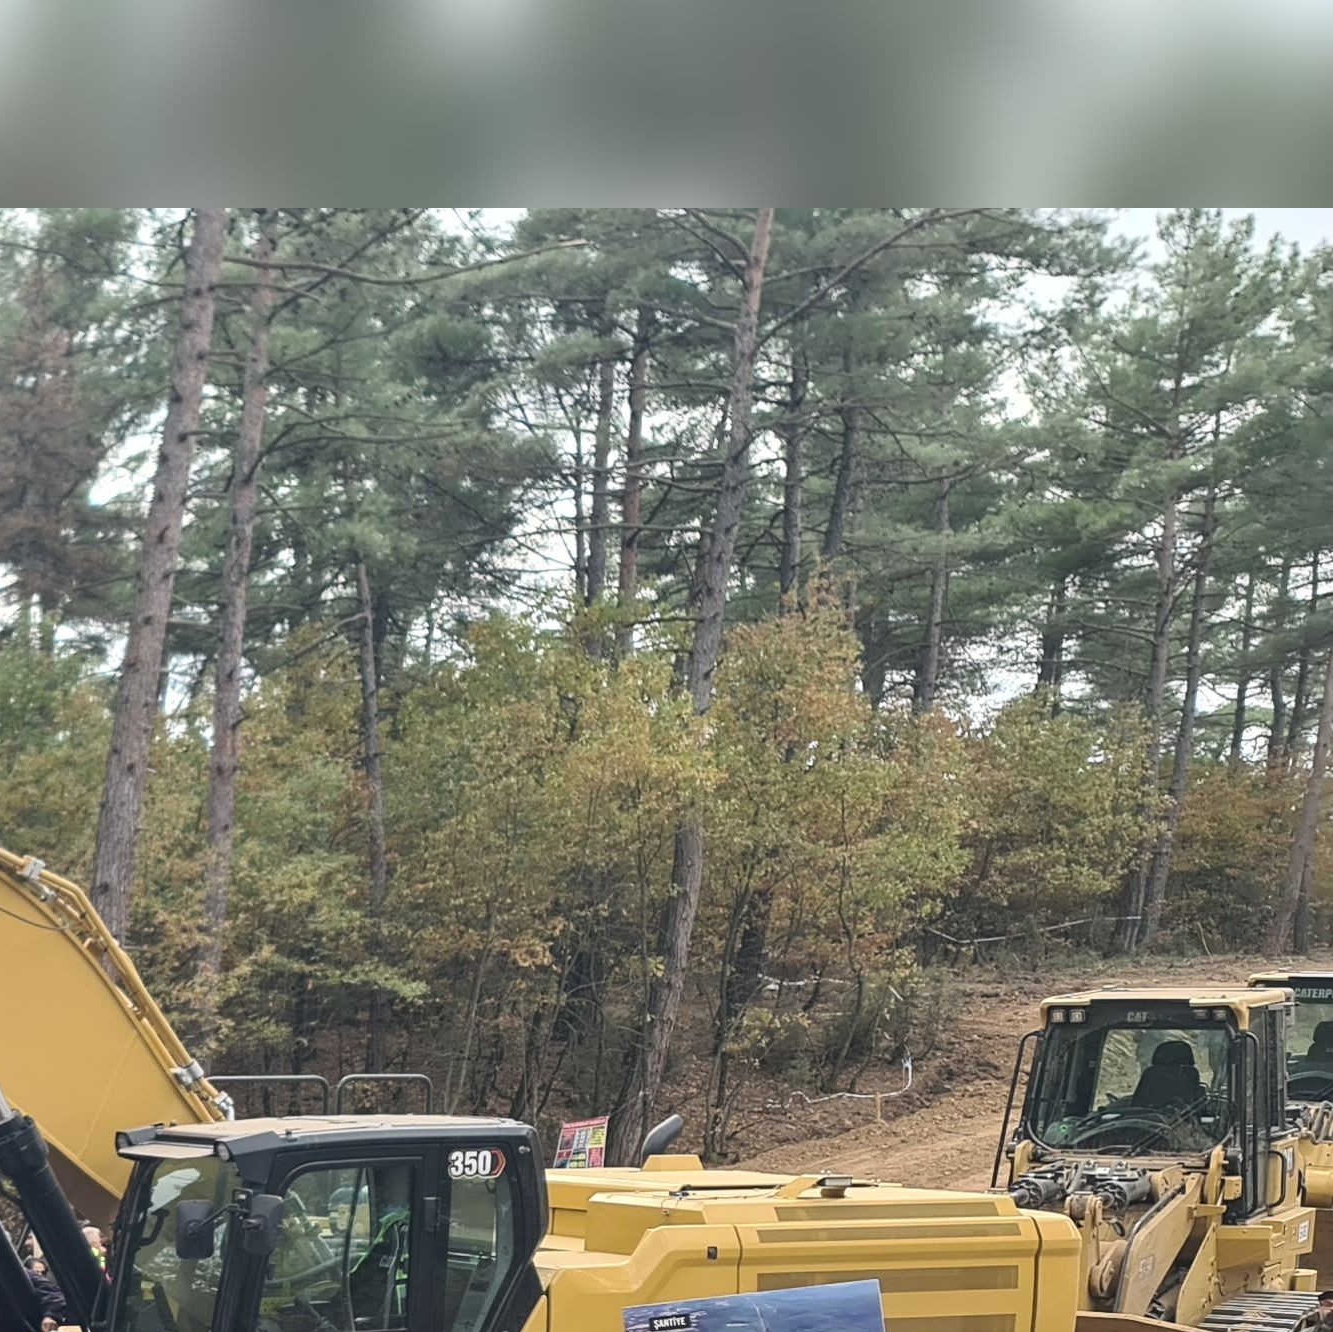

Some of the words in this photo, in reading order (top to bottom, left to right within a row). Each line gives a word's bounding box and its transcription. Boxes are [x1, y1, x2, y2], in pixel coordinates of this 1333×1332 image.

[1294, 988, 1333, 999] CATERP
[1127, 1011, 1148, 1022] CAT
[450, 1150, 492, 1176] 350
[653, 1316, 686, 1331] ŞANTİYE
